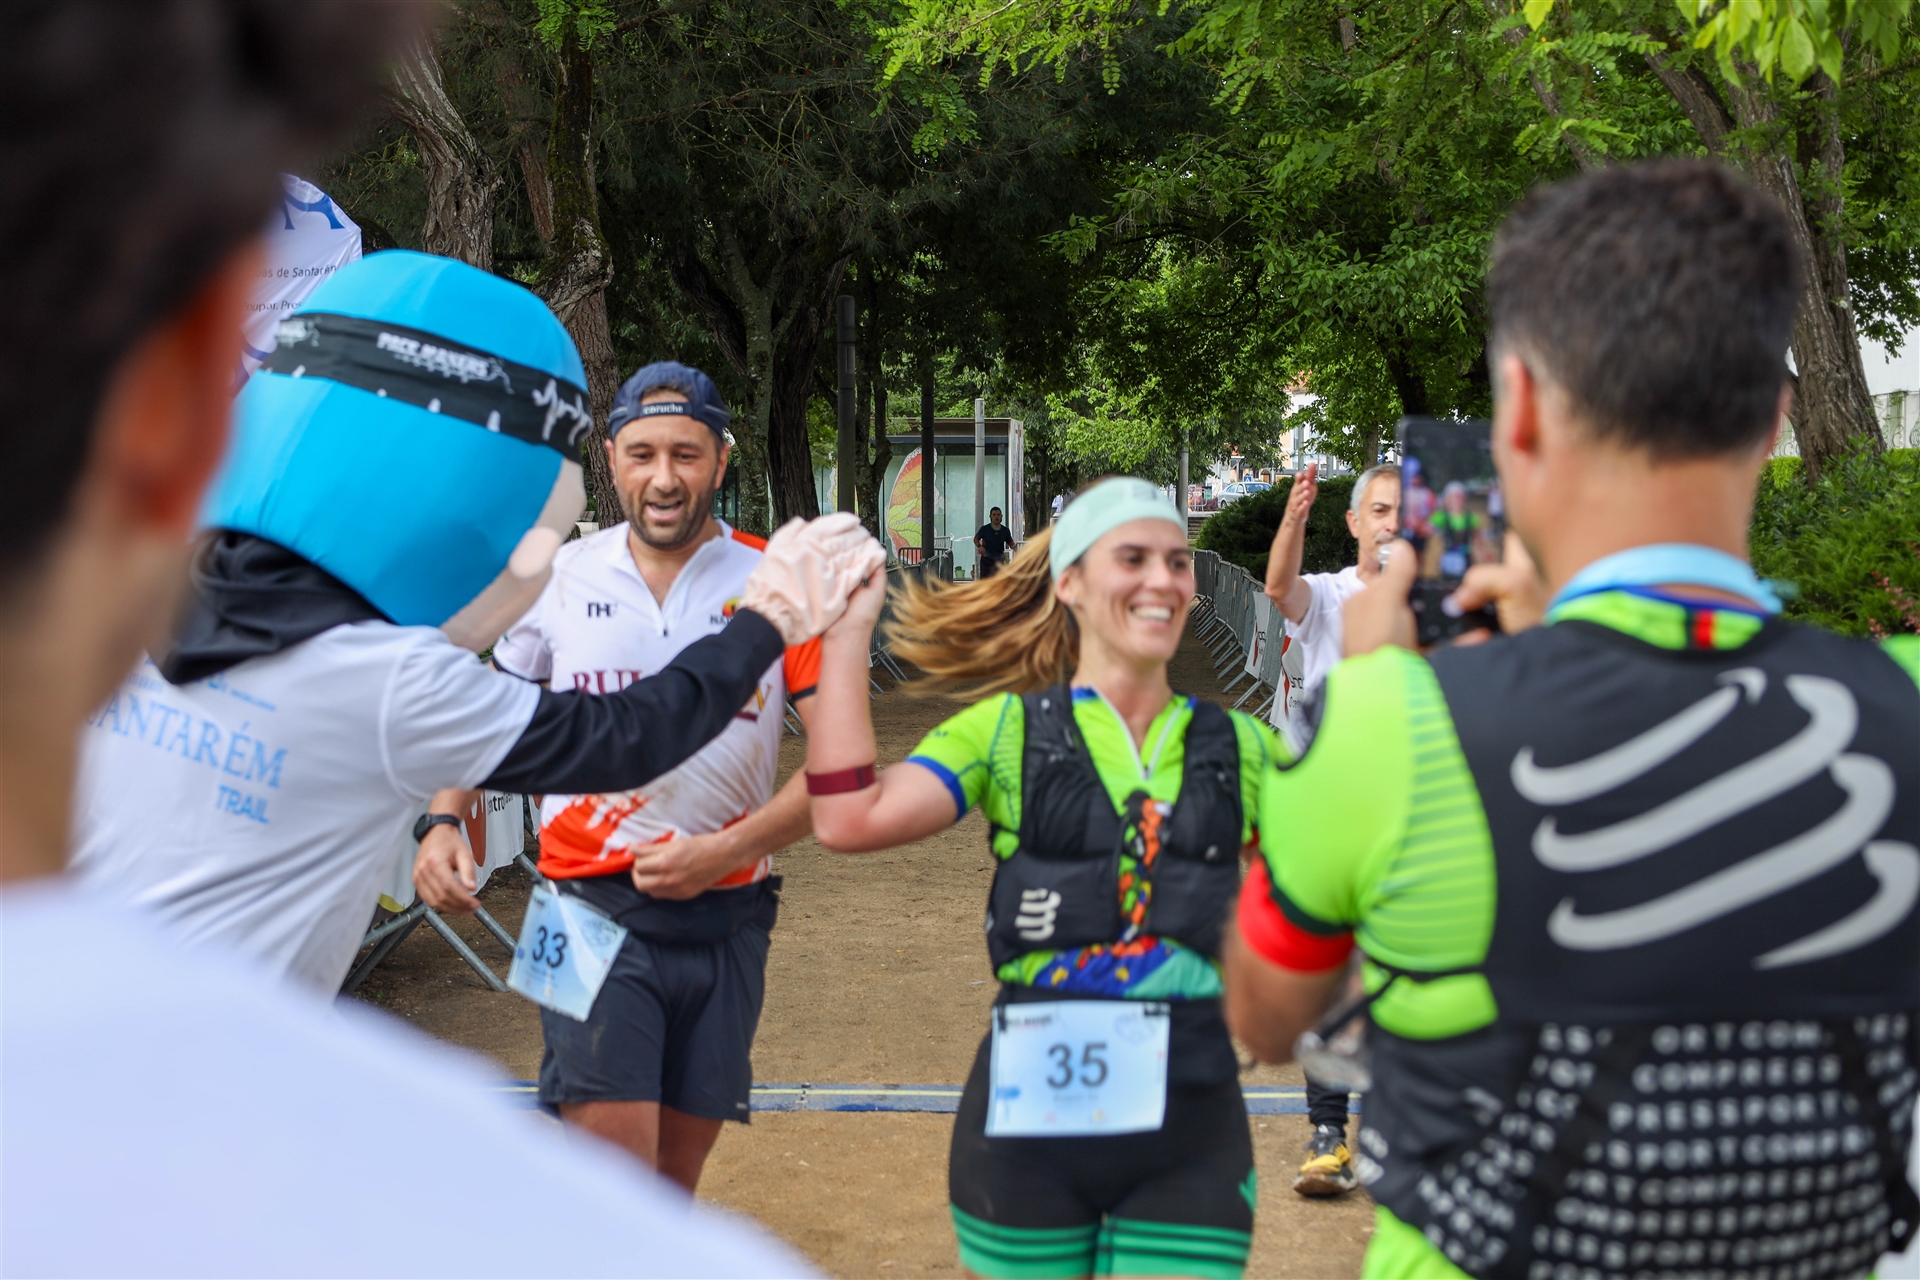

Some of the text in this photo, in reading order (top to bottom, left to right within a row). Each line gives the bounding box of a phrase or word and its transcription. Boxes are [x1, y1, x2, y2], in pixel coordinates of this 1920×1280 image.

[277, 267, 289, 277] de
[642, 403, 684, 415] coruche
[88, 690, 289, 790] ANTARÉM
[215, 784, 270, 824] TRAIL
[532, 924, 569, 969] 33
[1046, 1041, 1110, 1090] 35
